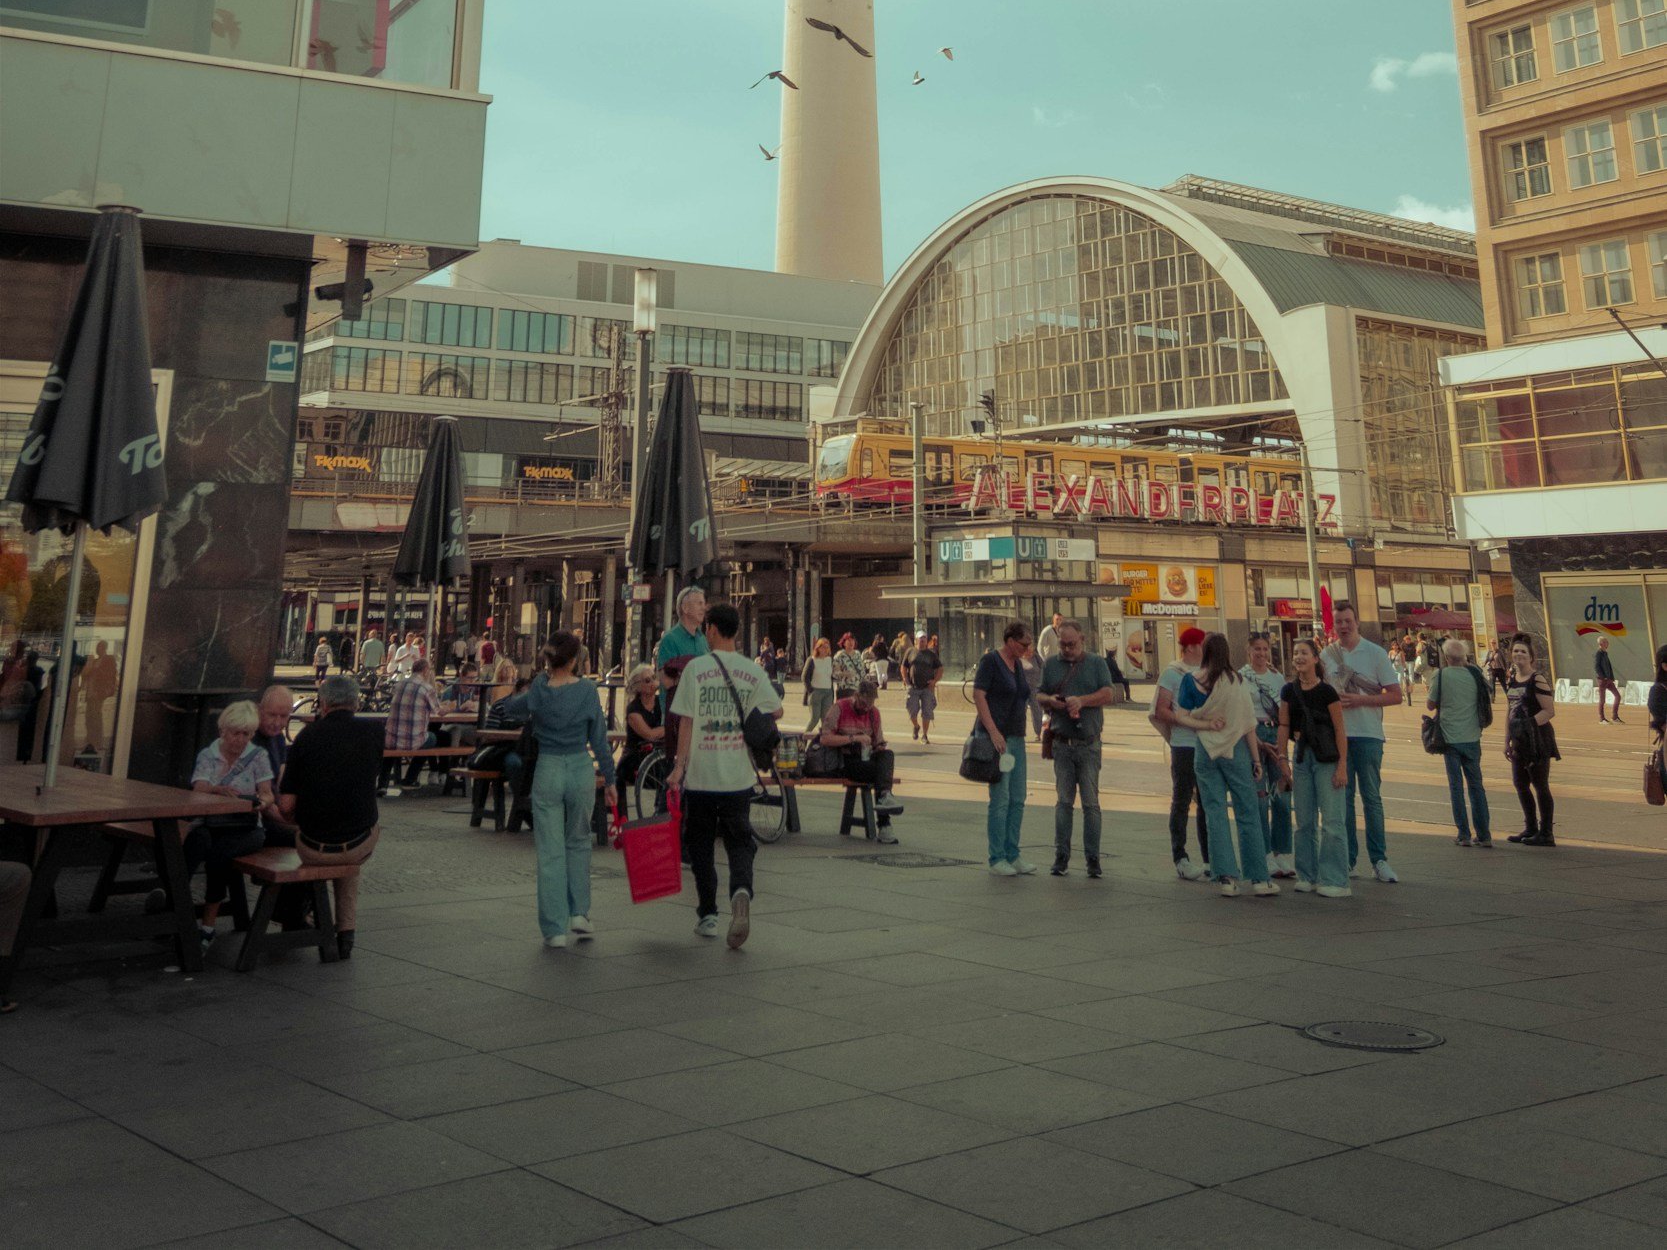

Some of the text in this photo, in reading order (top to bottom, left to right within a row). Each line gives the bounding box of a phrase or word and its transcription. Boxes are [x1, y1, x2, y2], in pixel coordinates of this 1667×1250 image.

[940, 541, 950, 561] U
[1018, 537, 1030, 557] U
[1142, 602, 1199, 615] McDonald's
[1584, 596, 1620, 622] dm
[696, 669, 759, 686] PICK SIDE
